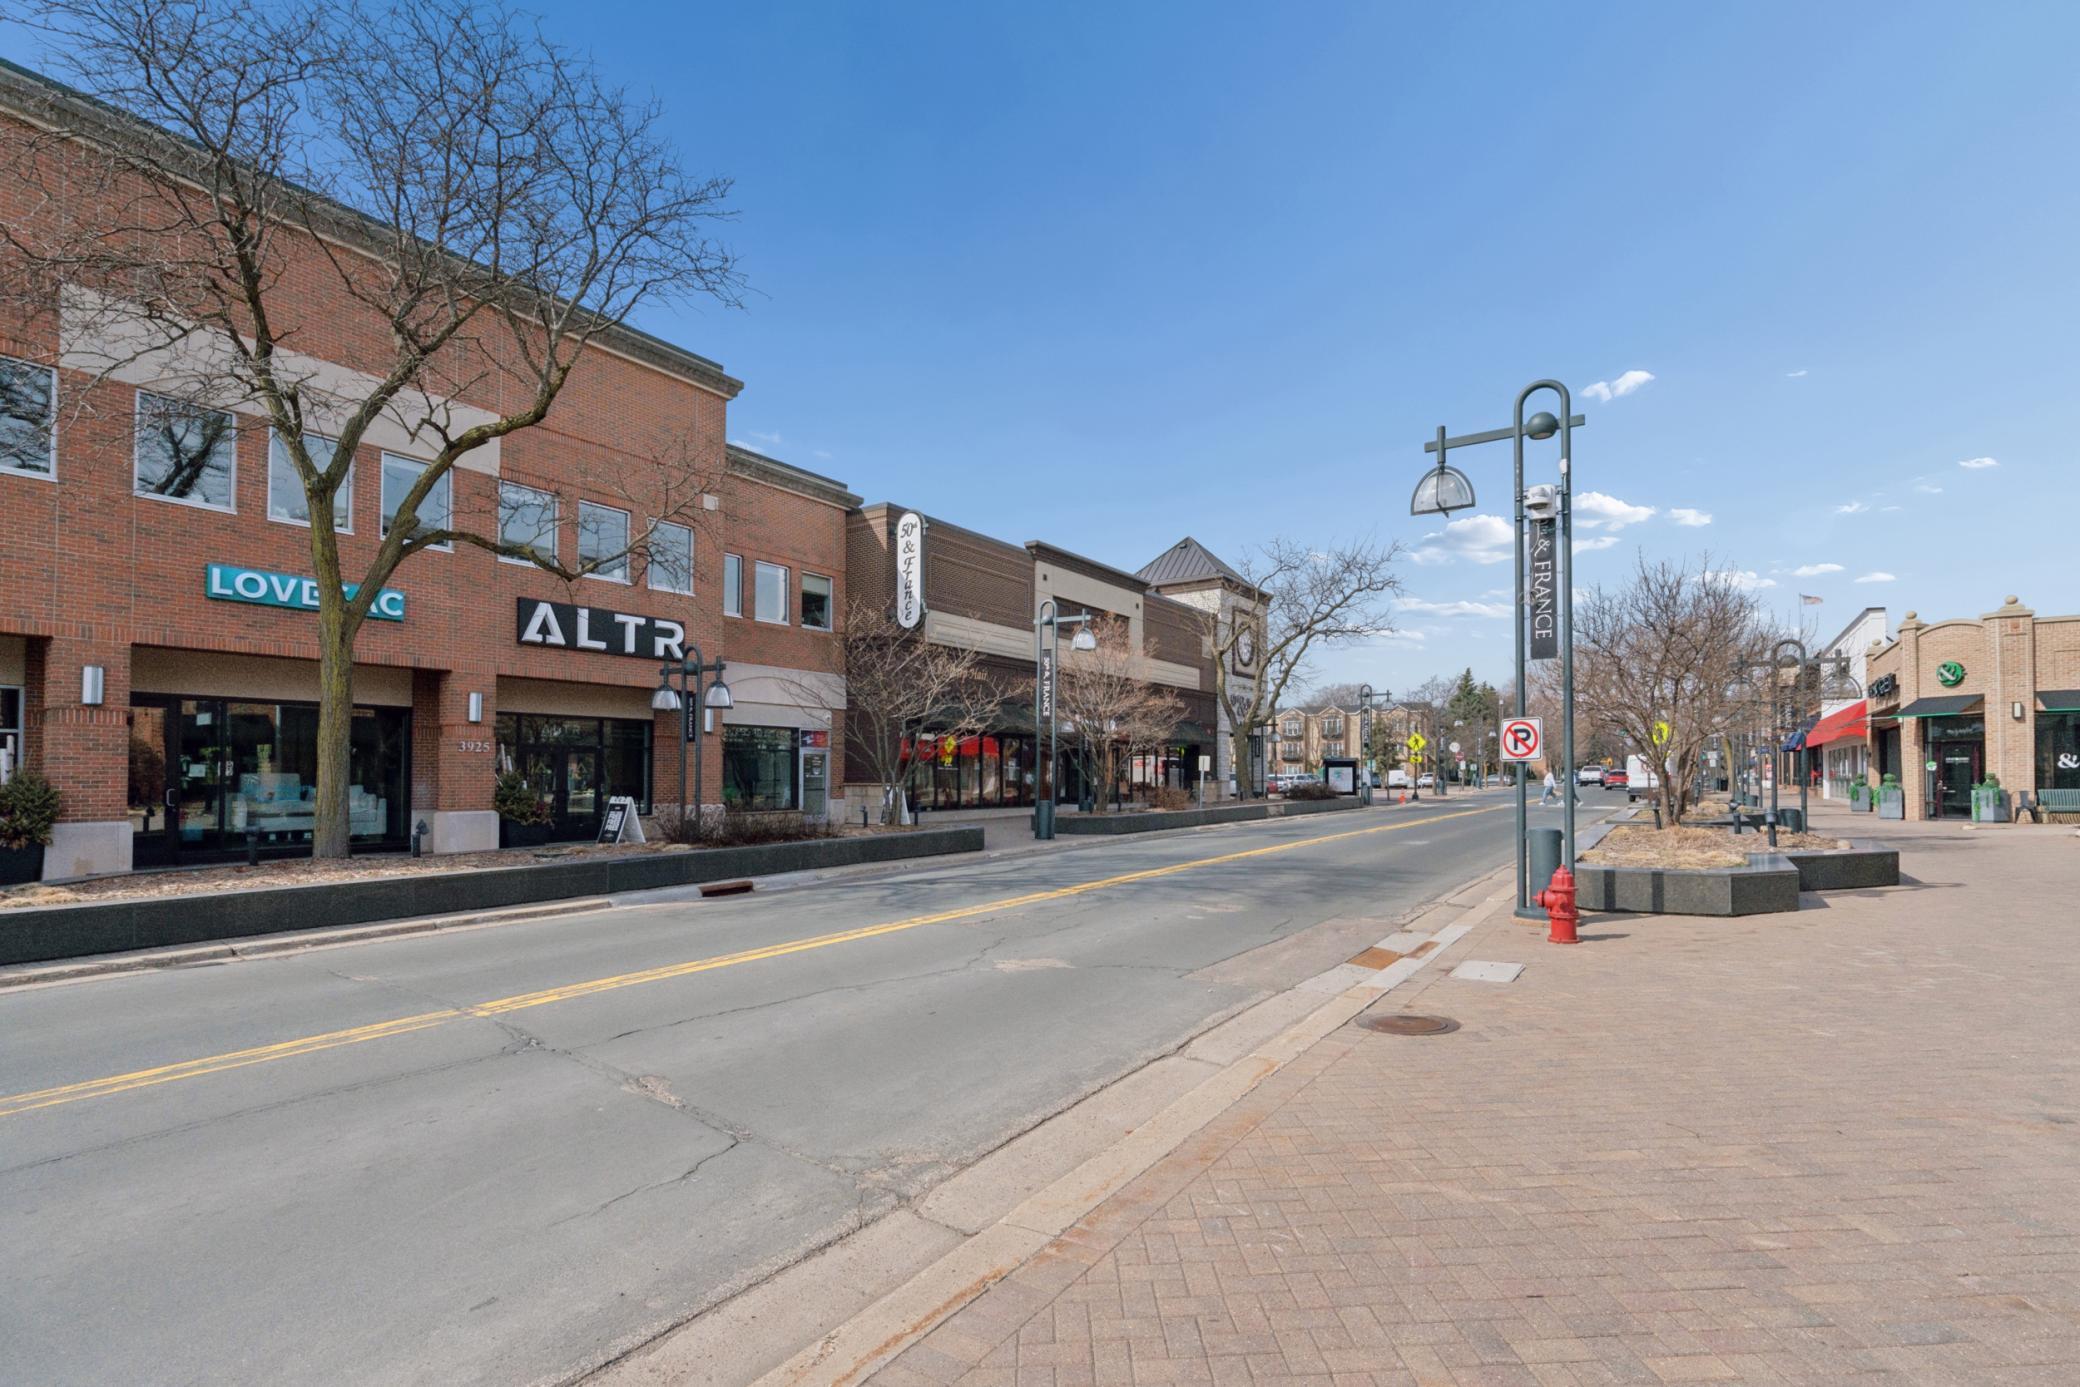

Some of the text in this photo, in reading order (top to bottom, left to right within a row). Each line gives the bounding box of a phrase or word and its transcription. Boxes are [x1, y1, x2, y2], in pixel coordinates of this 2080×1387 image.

[903, 540, 916, 554] &
[1534, 538, 1551, 557] &
[211, 567, 404, 617] LOVEC
[1534, 560, 1553, 639] FRANCE
[521, 602, 685, 660] ALTR
[1042, 681, 1051, 716] FRANCE
[457, 740, 490, 753] 3925
